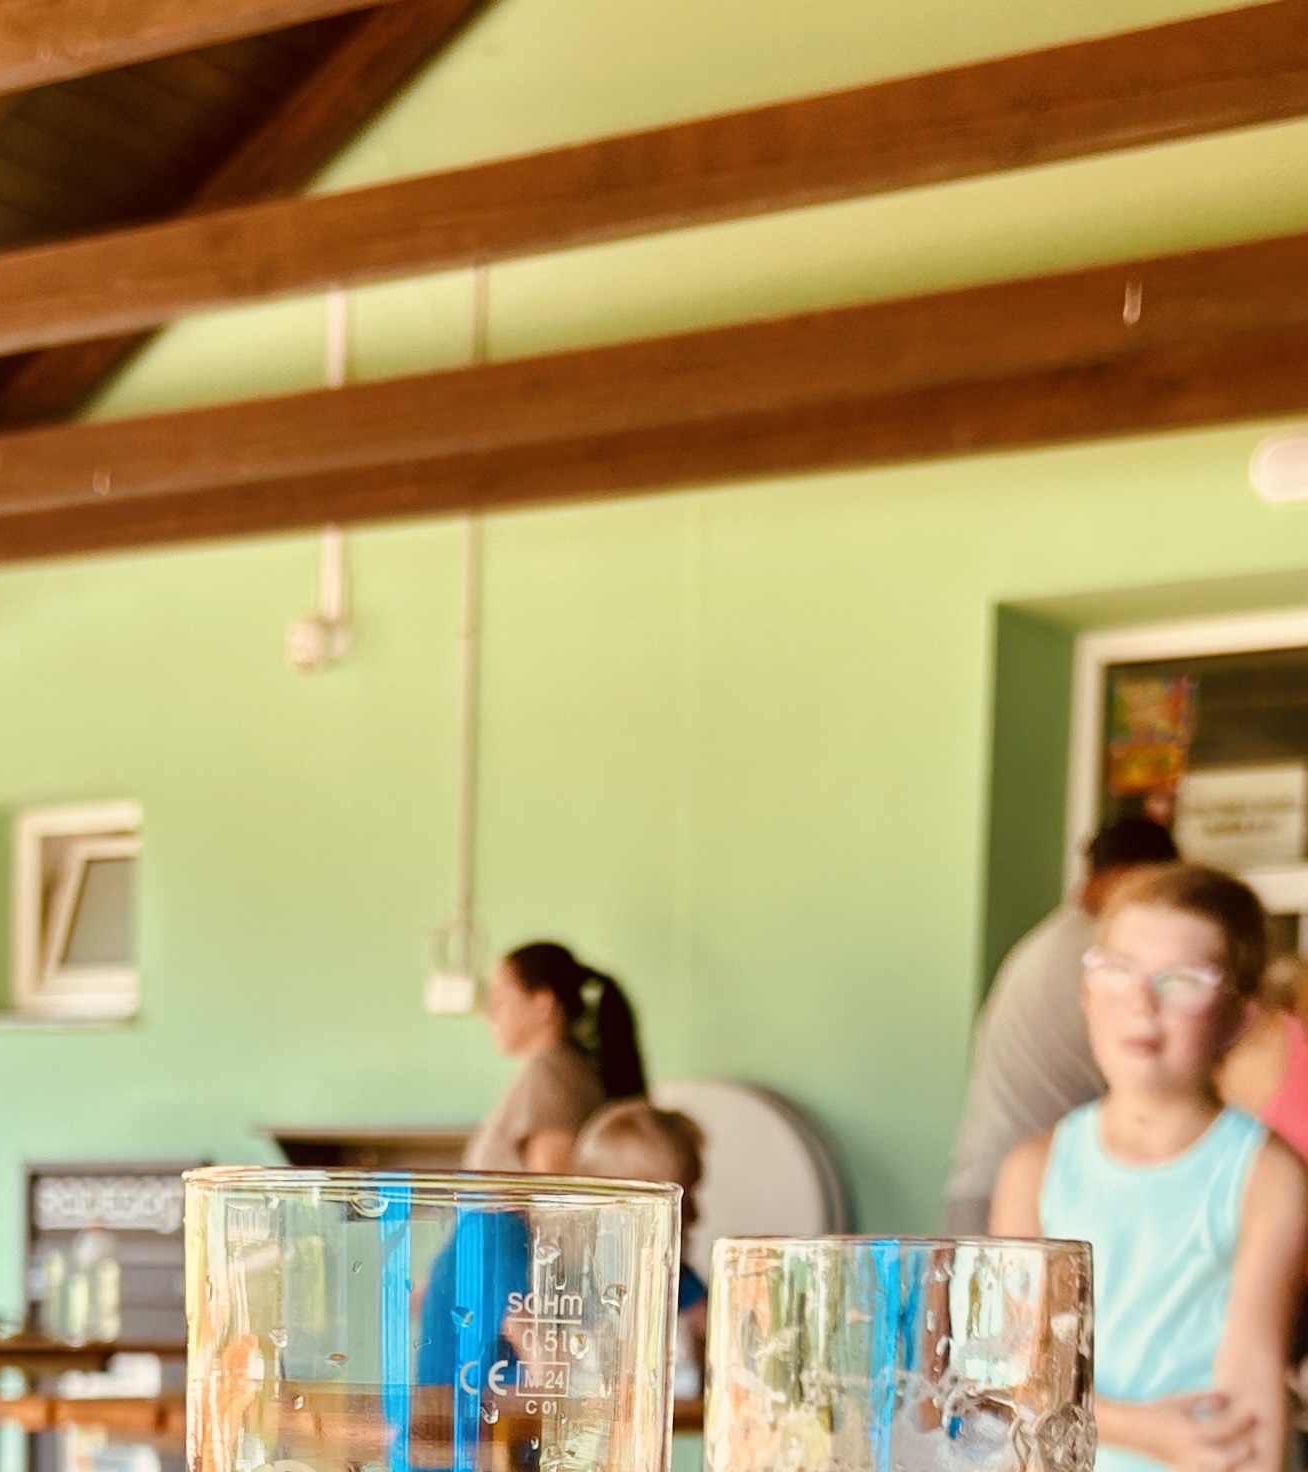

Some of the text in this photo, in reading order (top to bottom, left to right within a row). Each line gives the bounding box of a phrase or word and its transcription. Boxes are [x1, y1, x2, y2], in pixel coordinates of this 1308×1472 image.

[460, 1360, 509, 1396] CE
[545, 1370, 564, 1389] 24
[525, 1400, 538, 1415] C
